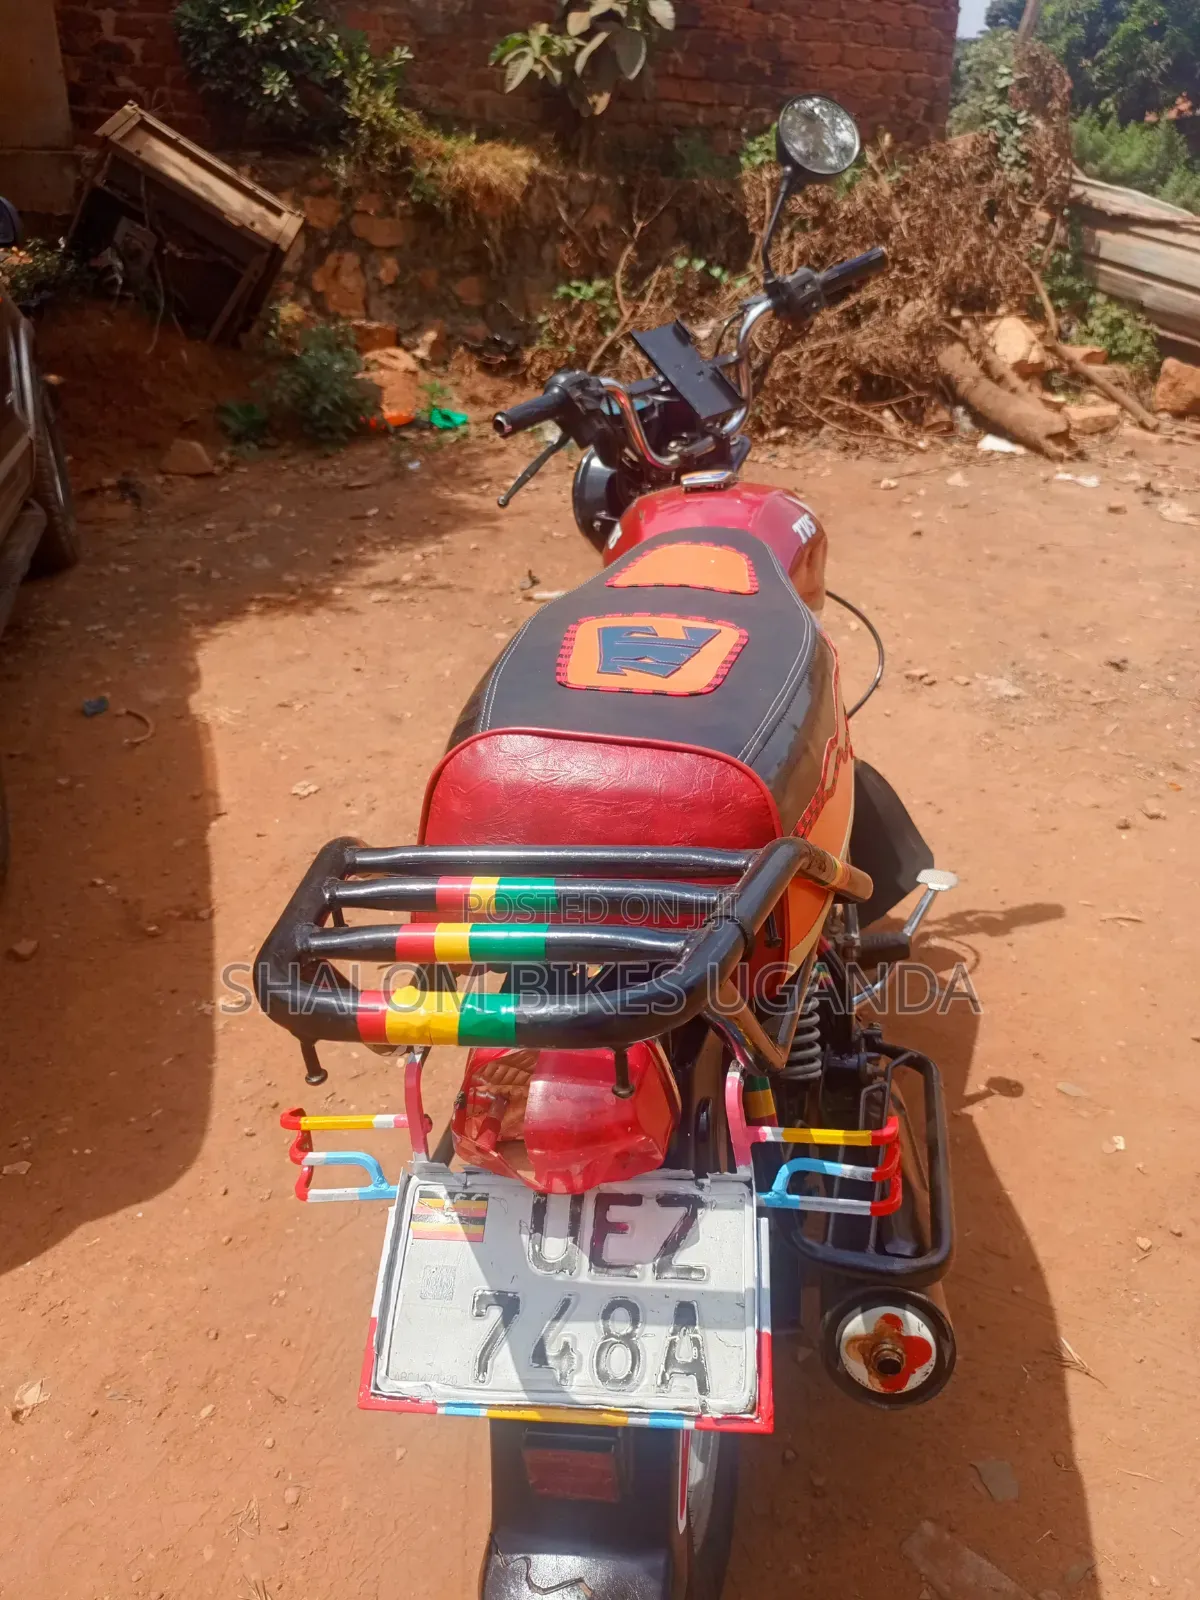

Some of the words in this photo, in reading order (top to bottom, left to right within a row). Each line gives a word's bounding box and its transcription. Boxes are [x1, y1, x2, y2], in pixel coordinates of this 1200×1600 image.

[792, 513, 817, 544] TVS
[527, 1191, 708, 1281] UEZ
[472, 1289, 711, 1396] 748A
